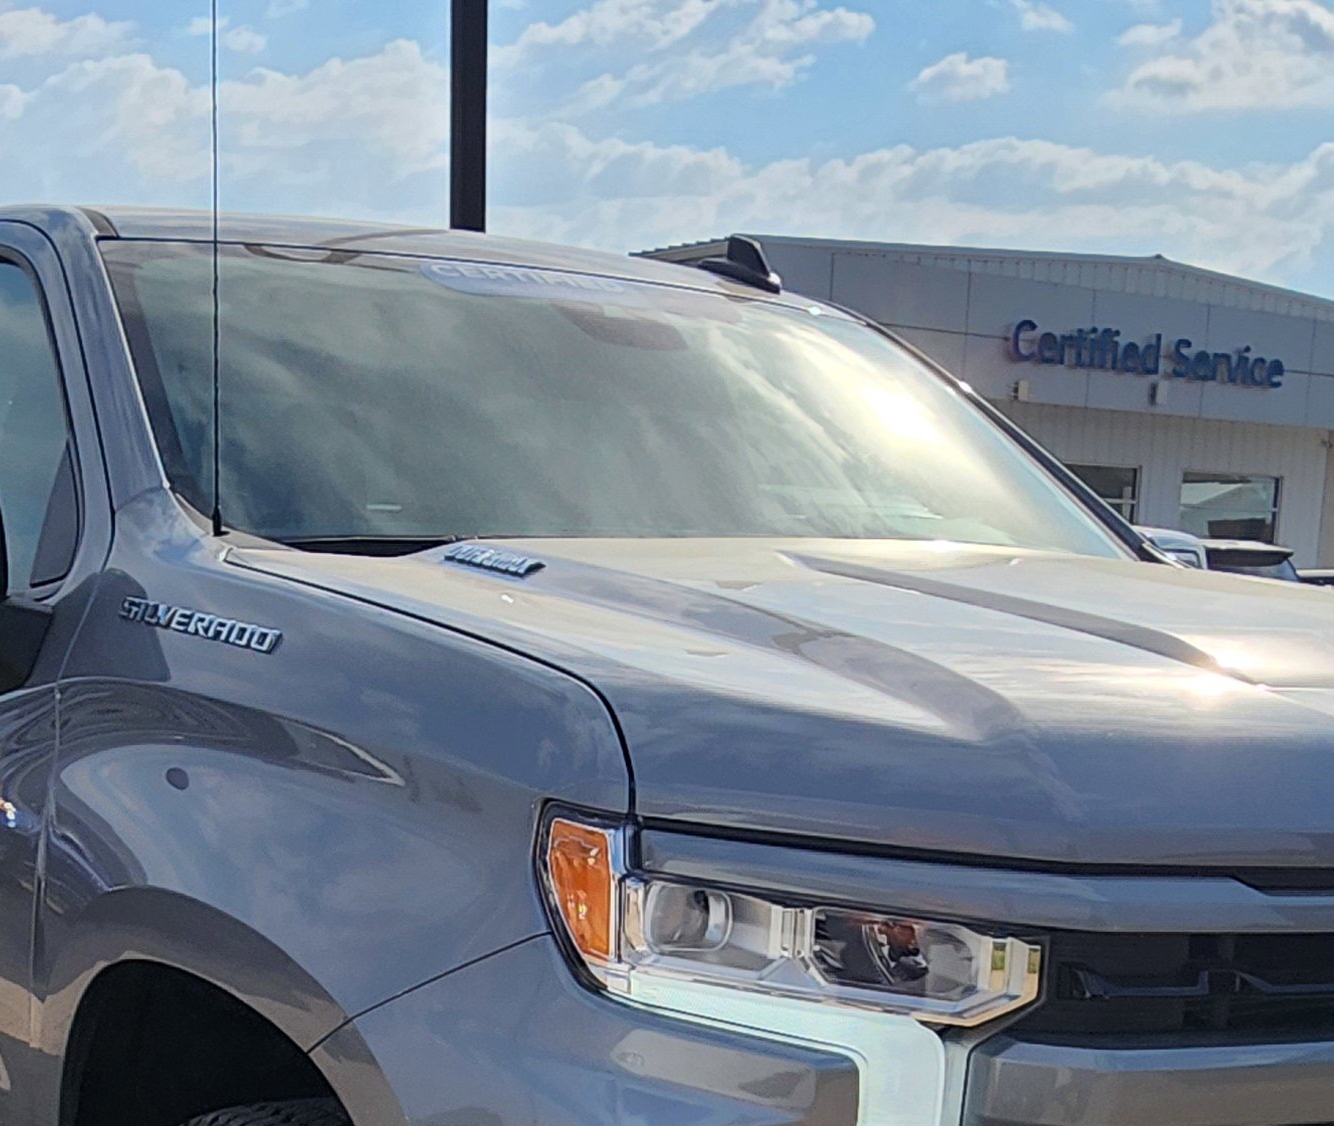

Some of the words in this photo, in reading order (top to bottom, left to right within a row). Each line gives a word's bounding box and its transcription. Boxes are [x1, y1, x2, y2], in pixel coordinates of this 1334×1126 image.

[431, 264, 624, 291] CERTIFIED
[1013, 319, 1162, 375] Certified
[1172, 338, 1285, 388] Service
[119, 596, 283, 654] SILVERADO
